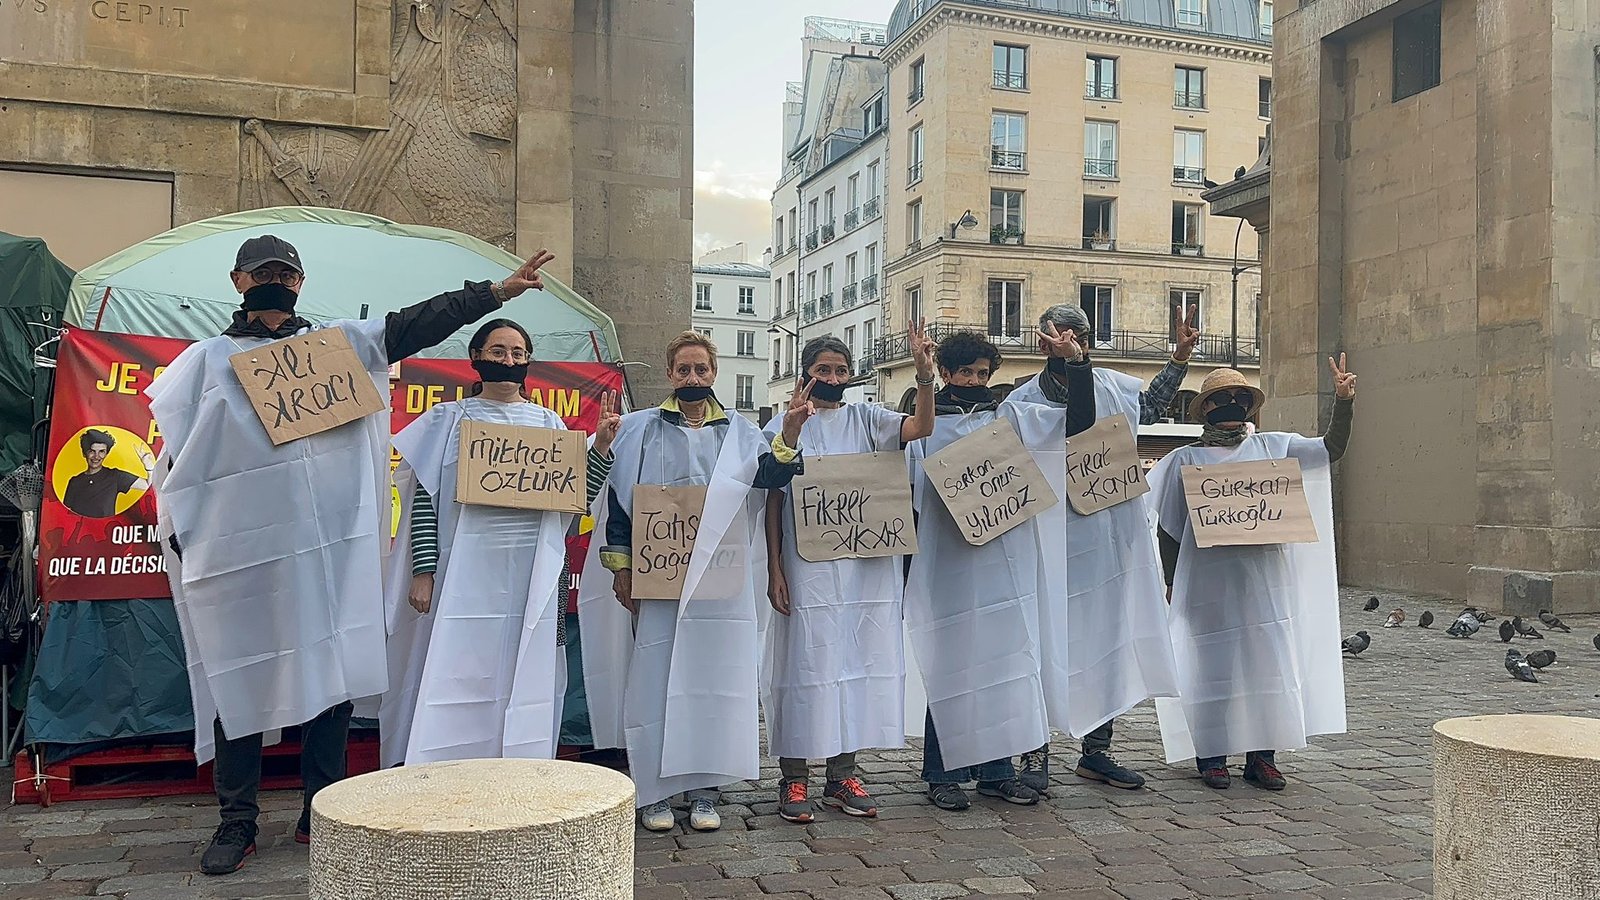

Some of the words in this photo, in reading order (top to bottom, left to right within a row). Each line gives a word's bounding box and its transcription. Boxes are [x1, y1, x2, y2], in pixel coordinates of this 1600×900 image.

[91, 0, 190, 28] CEPIT
[96, 362, 141, 395] JE
[406, 384, 445, 413] DE
[530, 388, 580, 417] AIM
[111, 525, 143, 545] QUE
[147, 524, 161, 543] M
[641, 510, 700, 548] Tahs
[49, 557, 82, 577] QUE
[84, 557, 106, 575] LA
